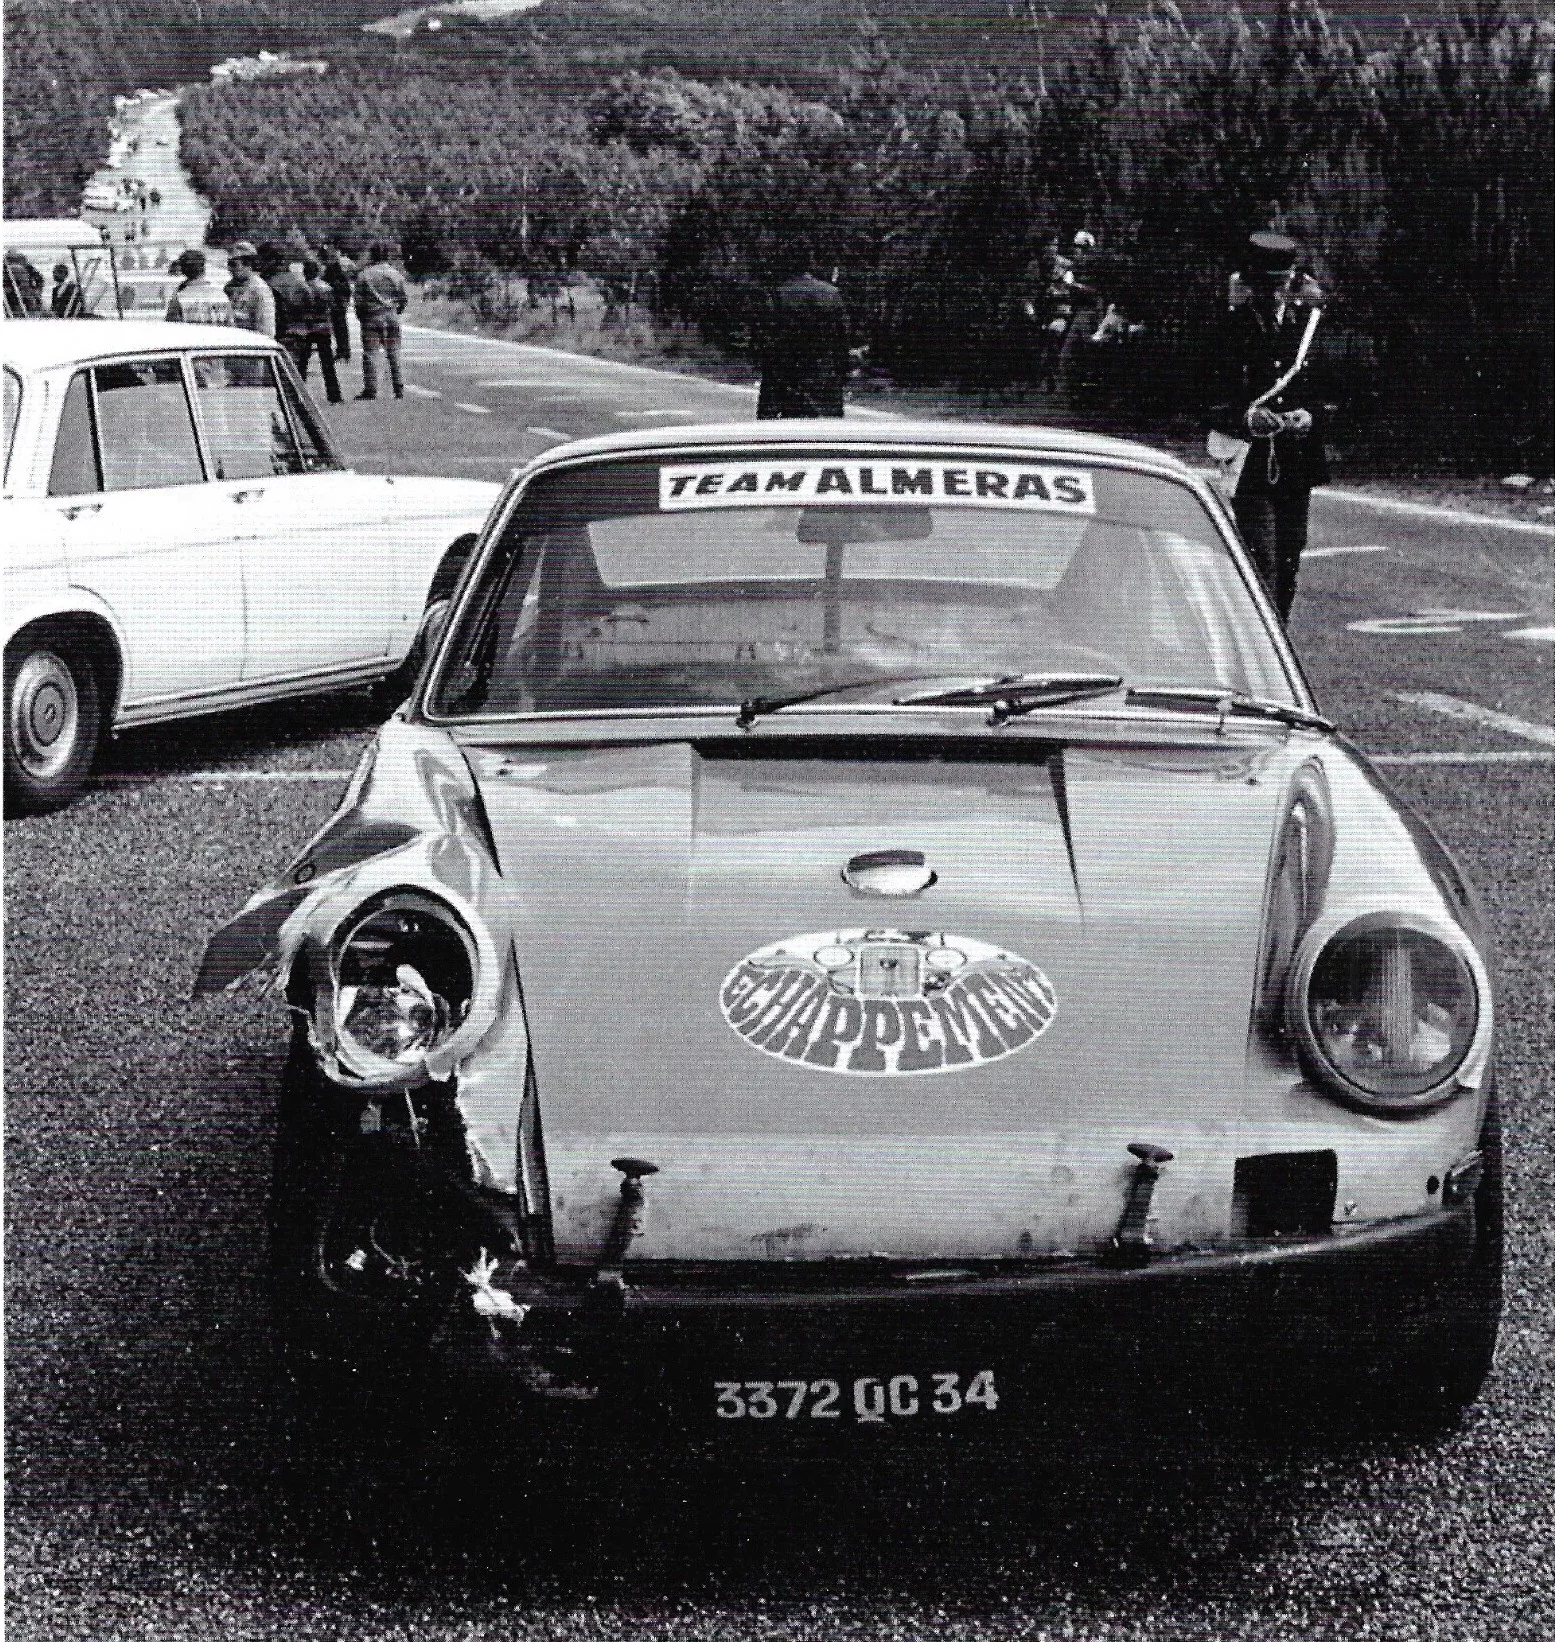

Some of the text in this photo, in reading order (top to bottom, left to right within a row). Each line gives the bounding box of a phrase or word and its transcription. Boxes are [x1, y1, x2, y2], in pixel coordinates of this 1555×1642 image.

[668, 467, 1087, 502] TEAM ALMERAS
[714, 1369, 1000, 1424] 3372 QC 34
